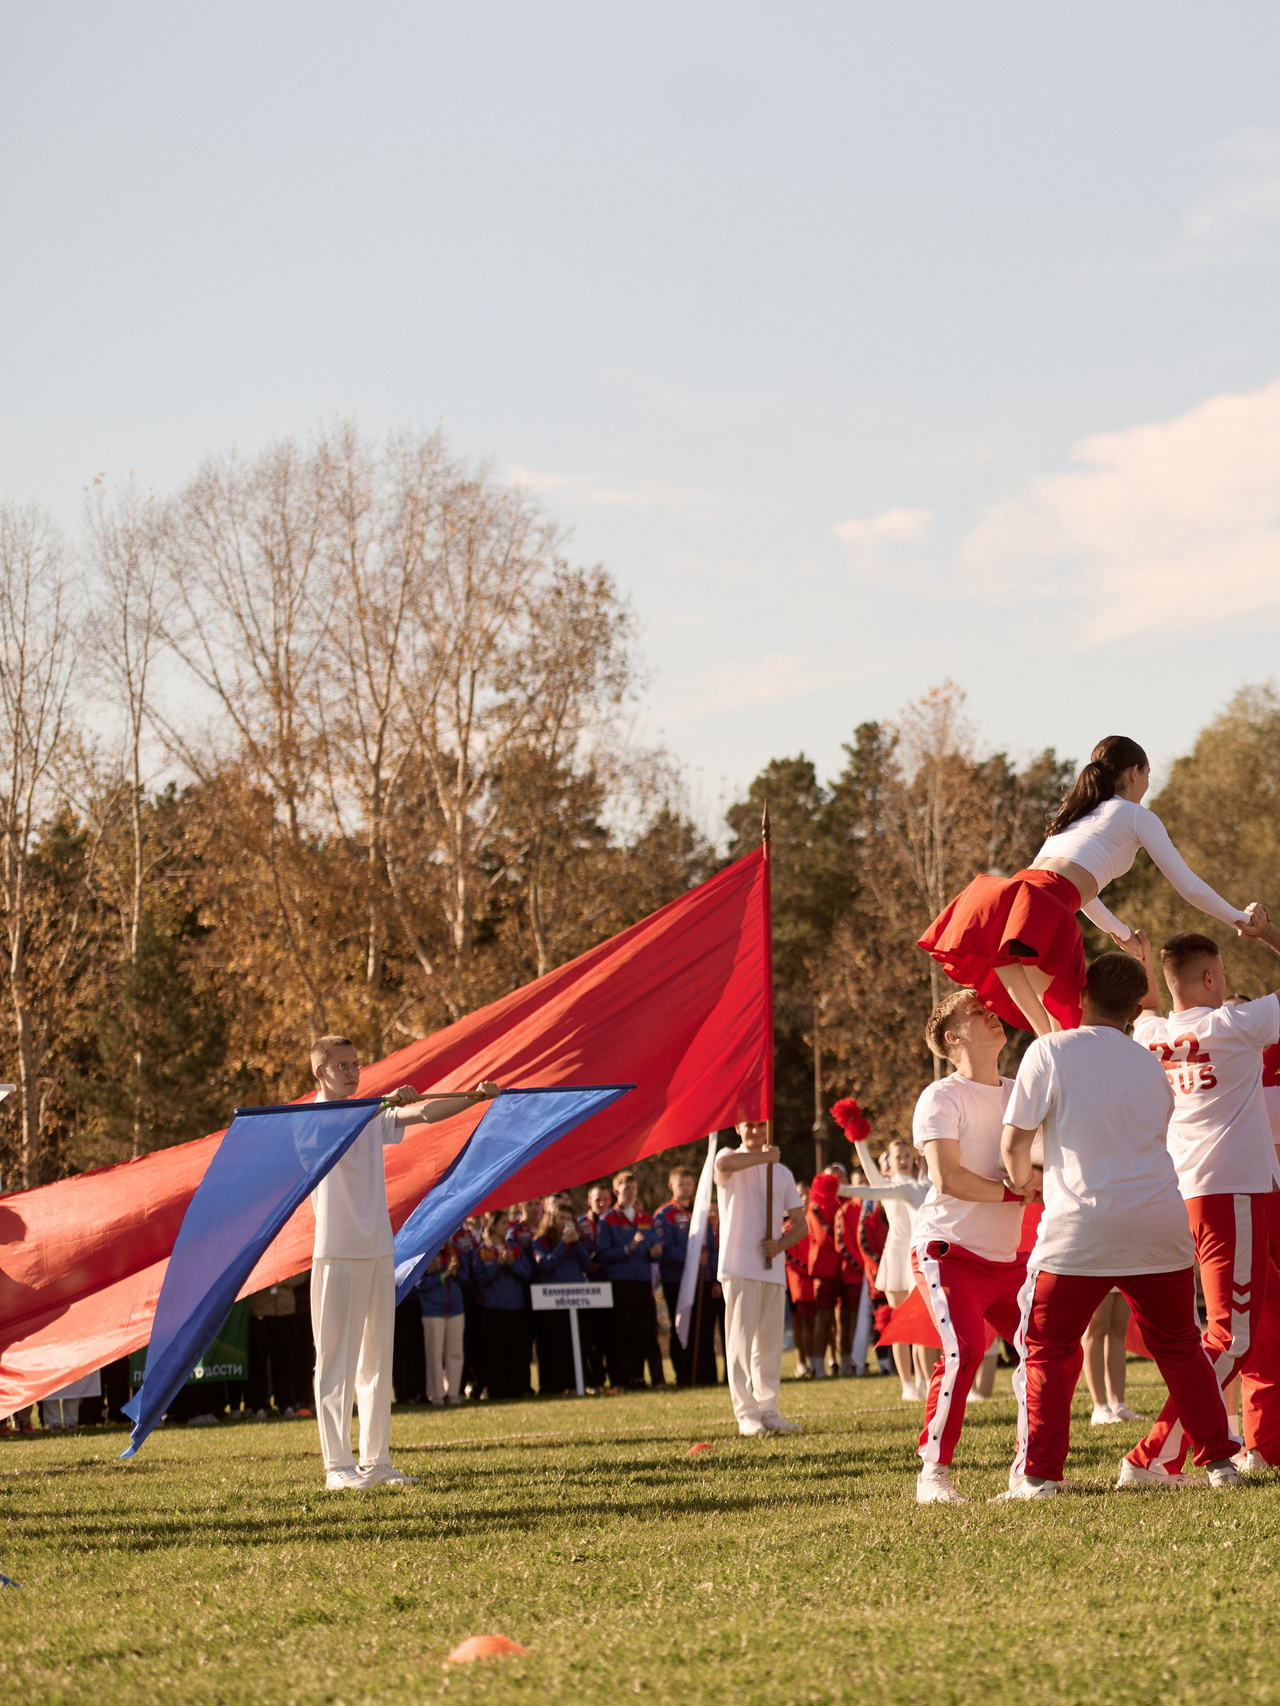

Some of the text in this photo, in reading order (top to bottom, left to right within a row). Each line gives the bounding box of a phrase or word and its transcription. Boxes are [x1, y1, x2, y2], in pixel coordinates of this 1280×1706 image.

[1149, 1031, 1211, 1071] 22
[542, 1287, 601, 1297] Кемеровская
[555, 1298, 591, 1307] область
